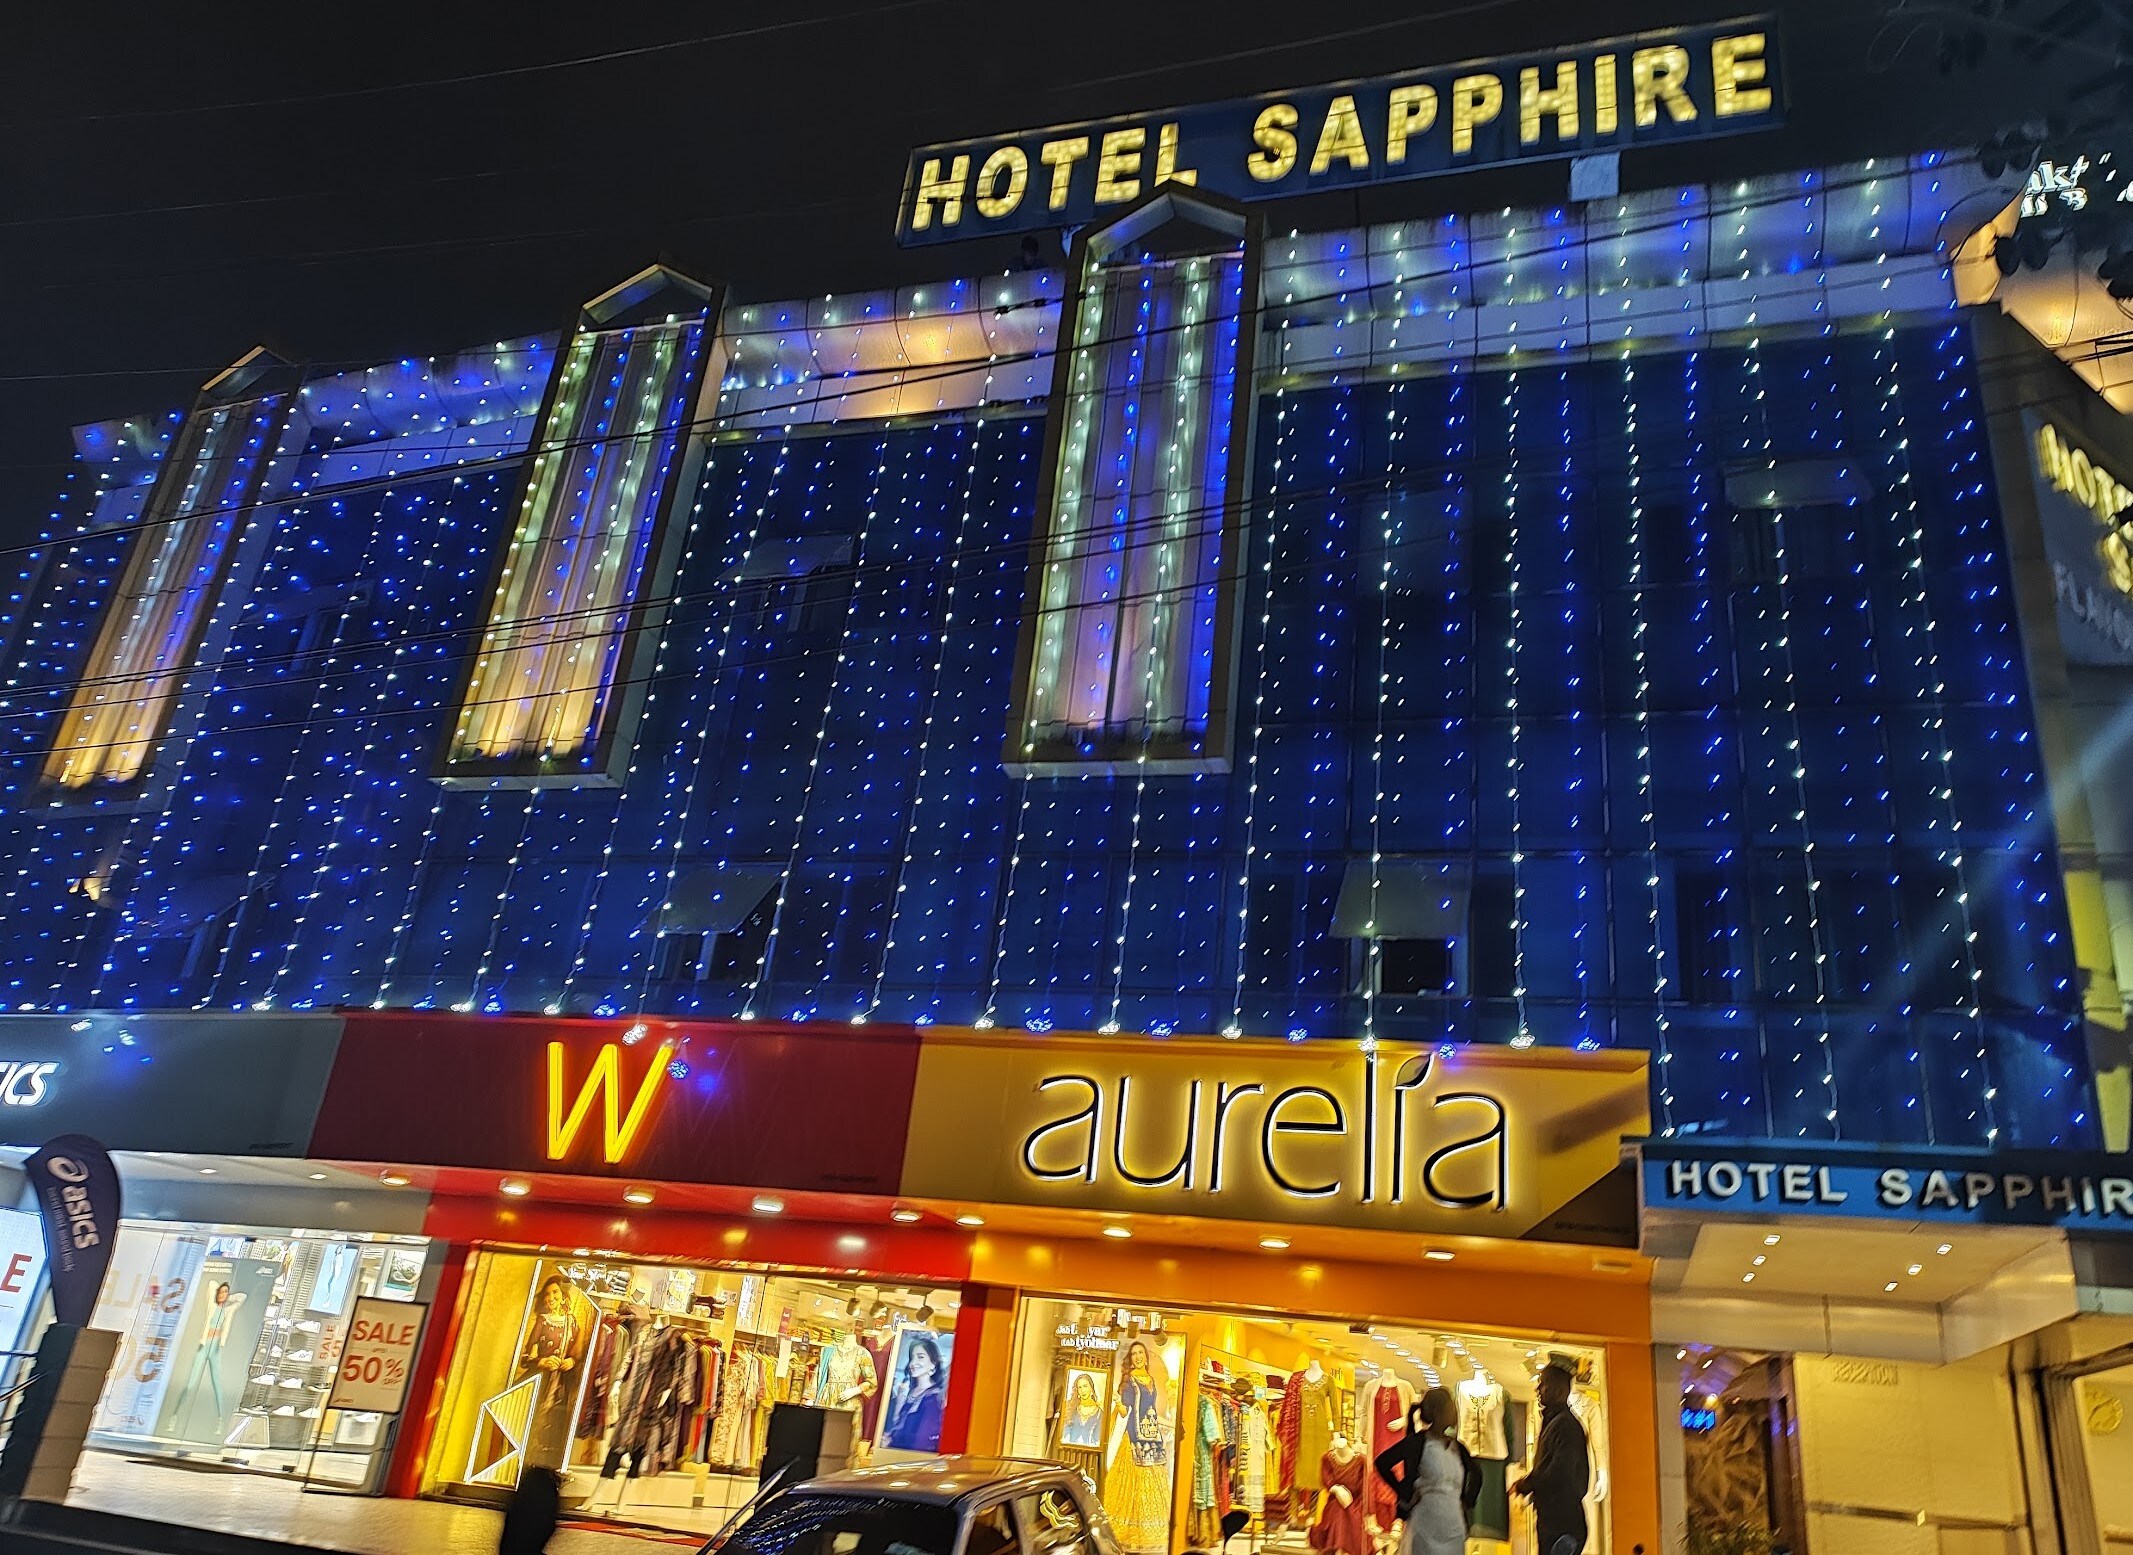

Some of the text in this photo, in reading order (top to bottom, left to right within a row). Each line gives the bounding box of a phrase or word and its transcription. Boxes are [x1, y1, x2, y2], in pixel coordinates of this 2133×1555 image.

[912, 32, 1772, 232] HOTEL SAPPHIRE
[547, 1041, 674, 1164] W
[1023, 1051, 1508, 1212] aurelia
[1671, 1160, 1848, 1202] HOTEL
[343, 1354, 405, 1384] 50%
[353, 1320, 416, 1346] SALE
